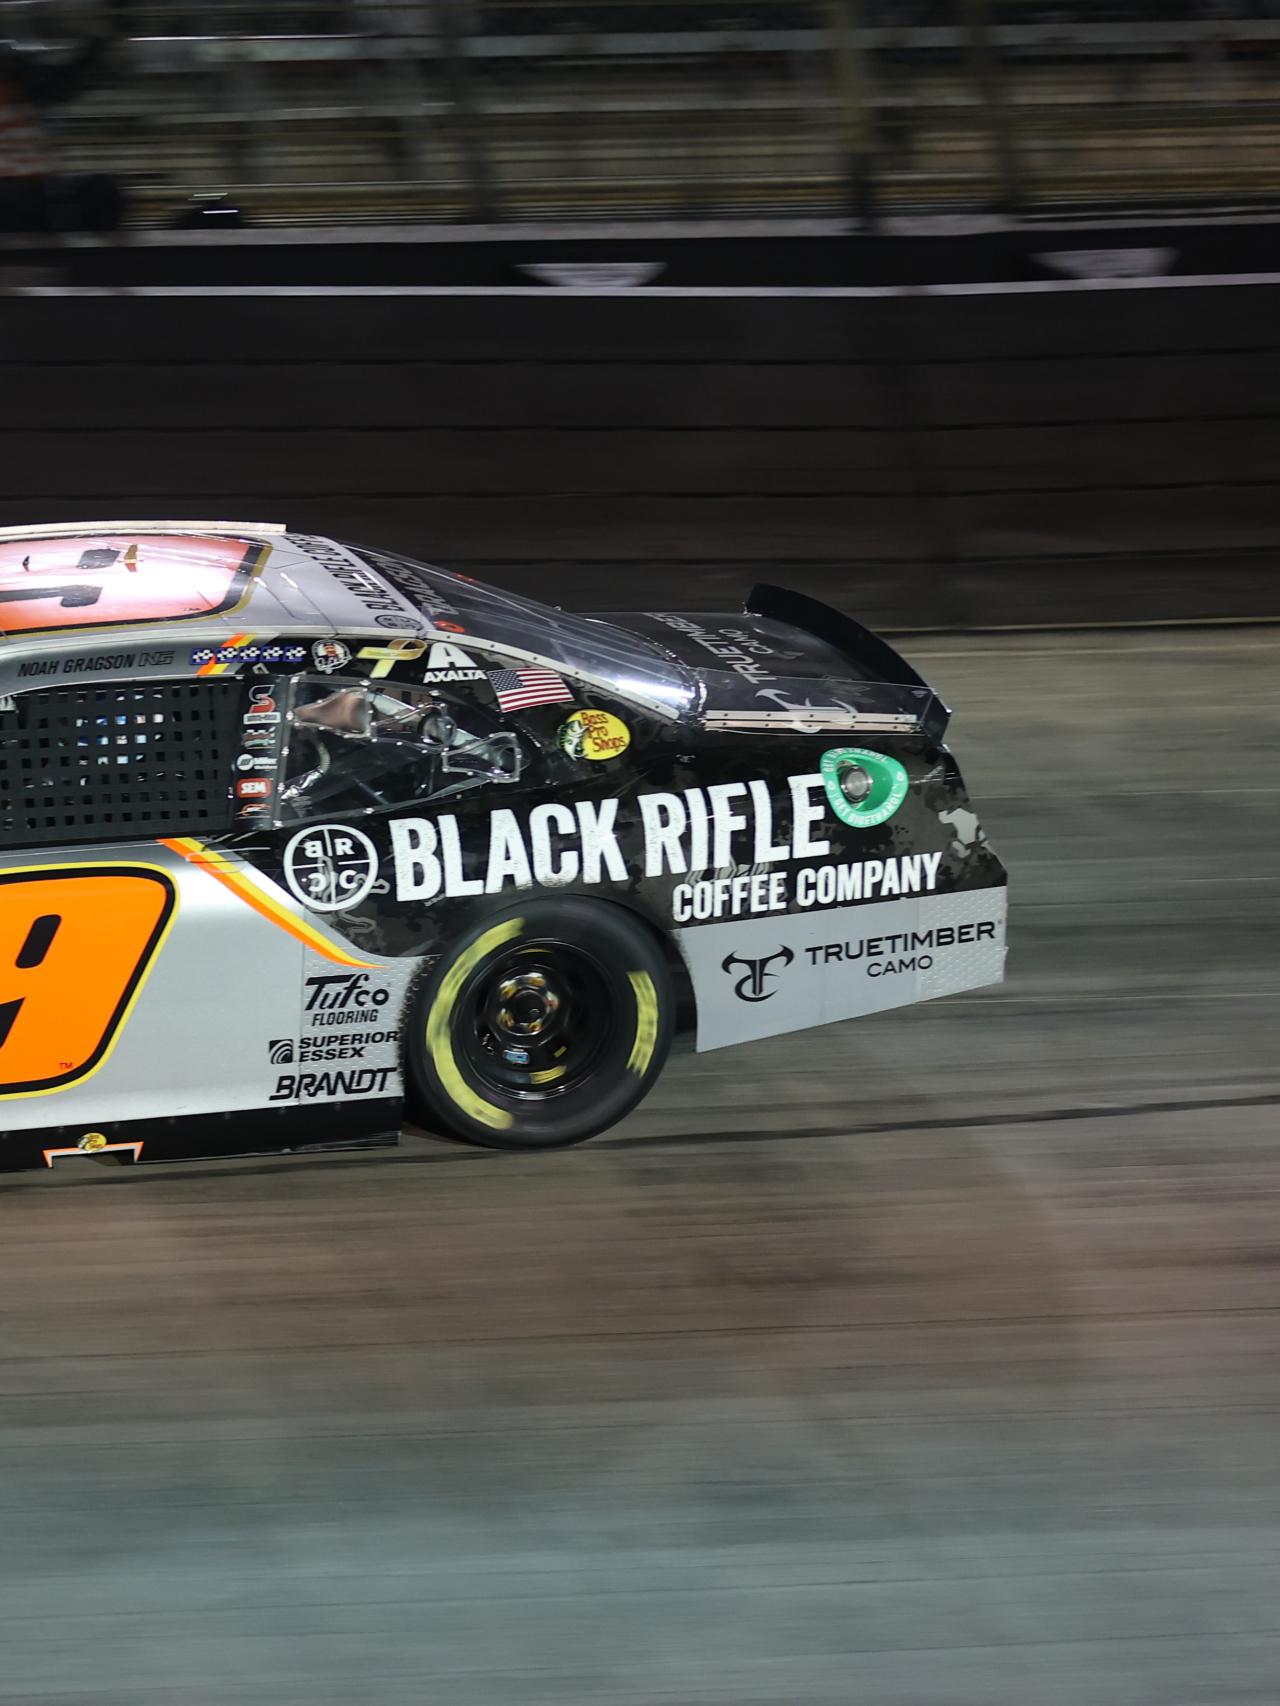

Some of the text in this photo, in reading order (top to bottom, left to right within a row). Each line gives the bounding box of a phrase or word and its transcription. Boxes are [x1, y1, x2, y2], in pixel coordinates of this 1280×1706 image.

[718, 628, 774, 655] CAMO
[17, 659, 59, 677] NOAH
[63, 653, 136, 673] GRAGSON
[423, 669, 488, 684] AXALTA
[580, 711, 609, 726] Bass
[588, 725, 609, 739] Pro
[592, 736, 627, 753] Shops
[240, 781, 267, 793] SEM
[388, 774, 831, 902] BLACK RIFLE
[672, 851, 943, 923] COFFEE COMPANY
[805, 920, 996, 966] TRUETIMBER
[867, 954, 934, 979] CAMO
[305, 973, 389, 1011] Tufco
[312, 1009, 379, 1027] FLOORING
[298, 1031, 400, 1049] SUPERIOR
[299, 1046, 366, 1063] ESSEX
[269, 1067, 398, 1101] BRANDT
